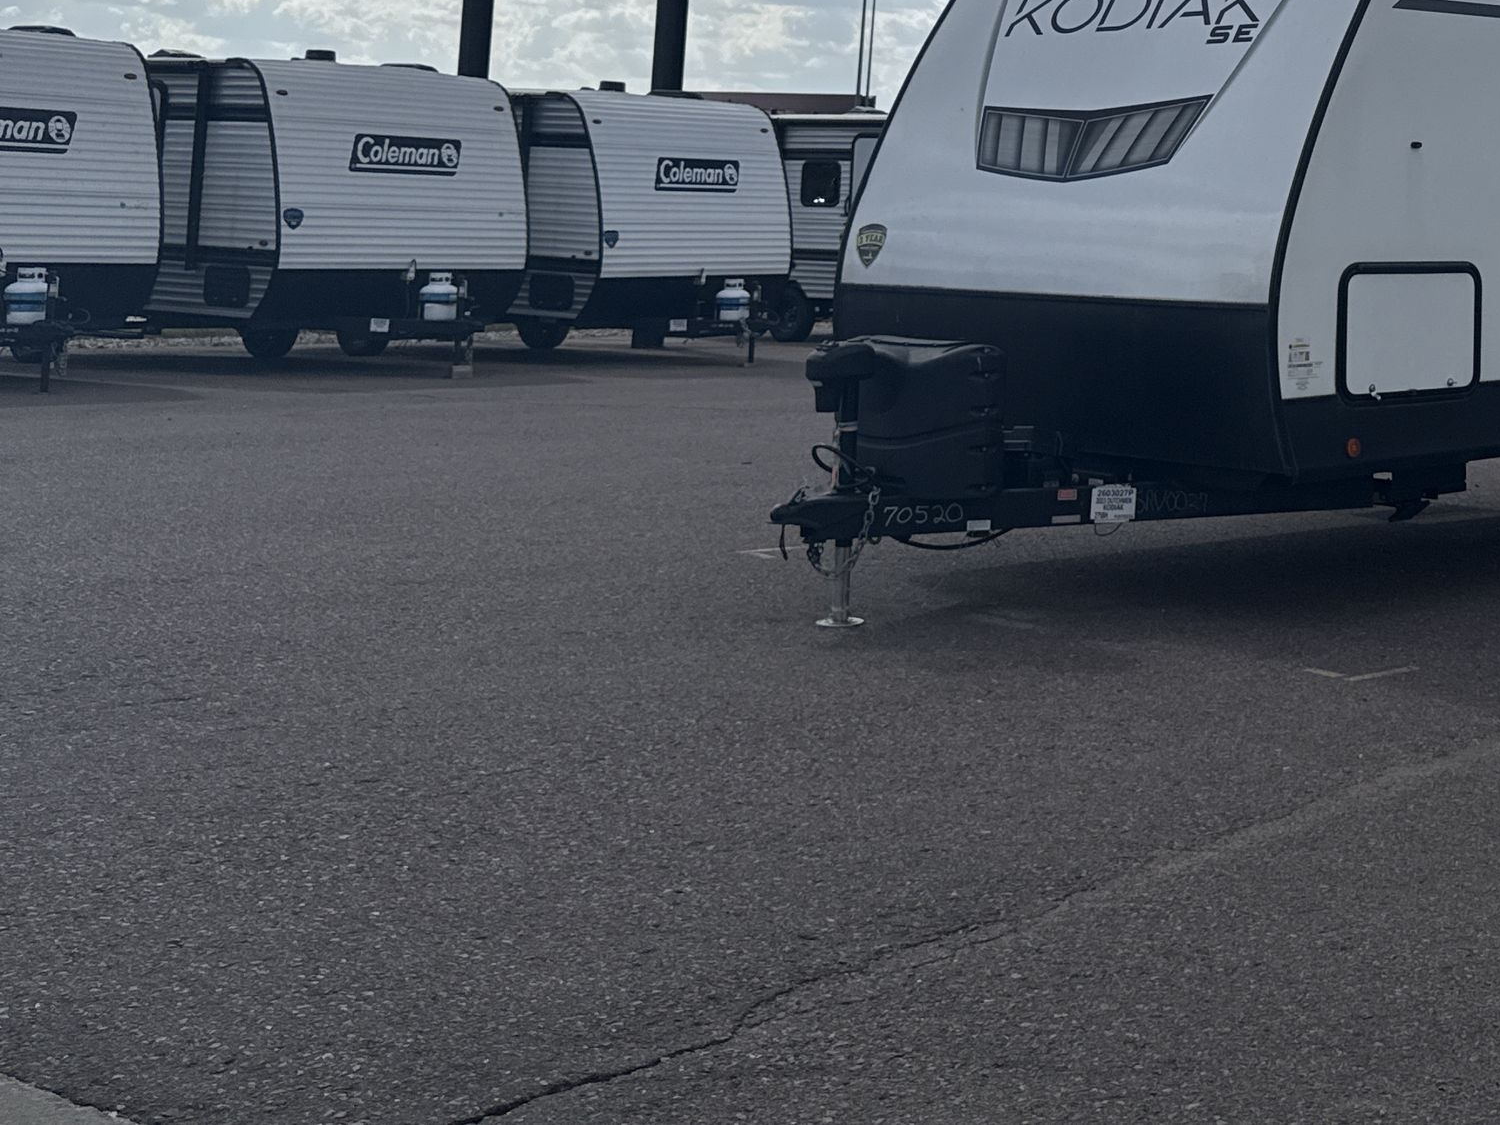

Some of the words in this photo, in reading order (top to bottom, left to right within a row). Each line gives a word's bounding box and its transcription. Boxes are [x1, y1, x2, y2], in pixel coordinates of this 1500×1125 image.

[1205, 23, 1259, 45] SE
[357, 136, 440, 165] Coleman
[660, 160, 723, 183] Coleman
[883, 502, 964, 527] 70520
